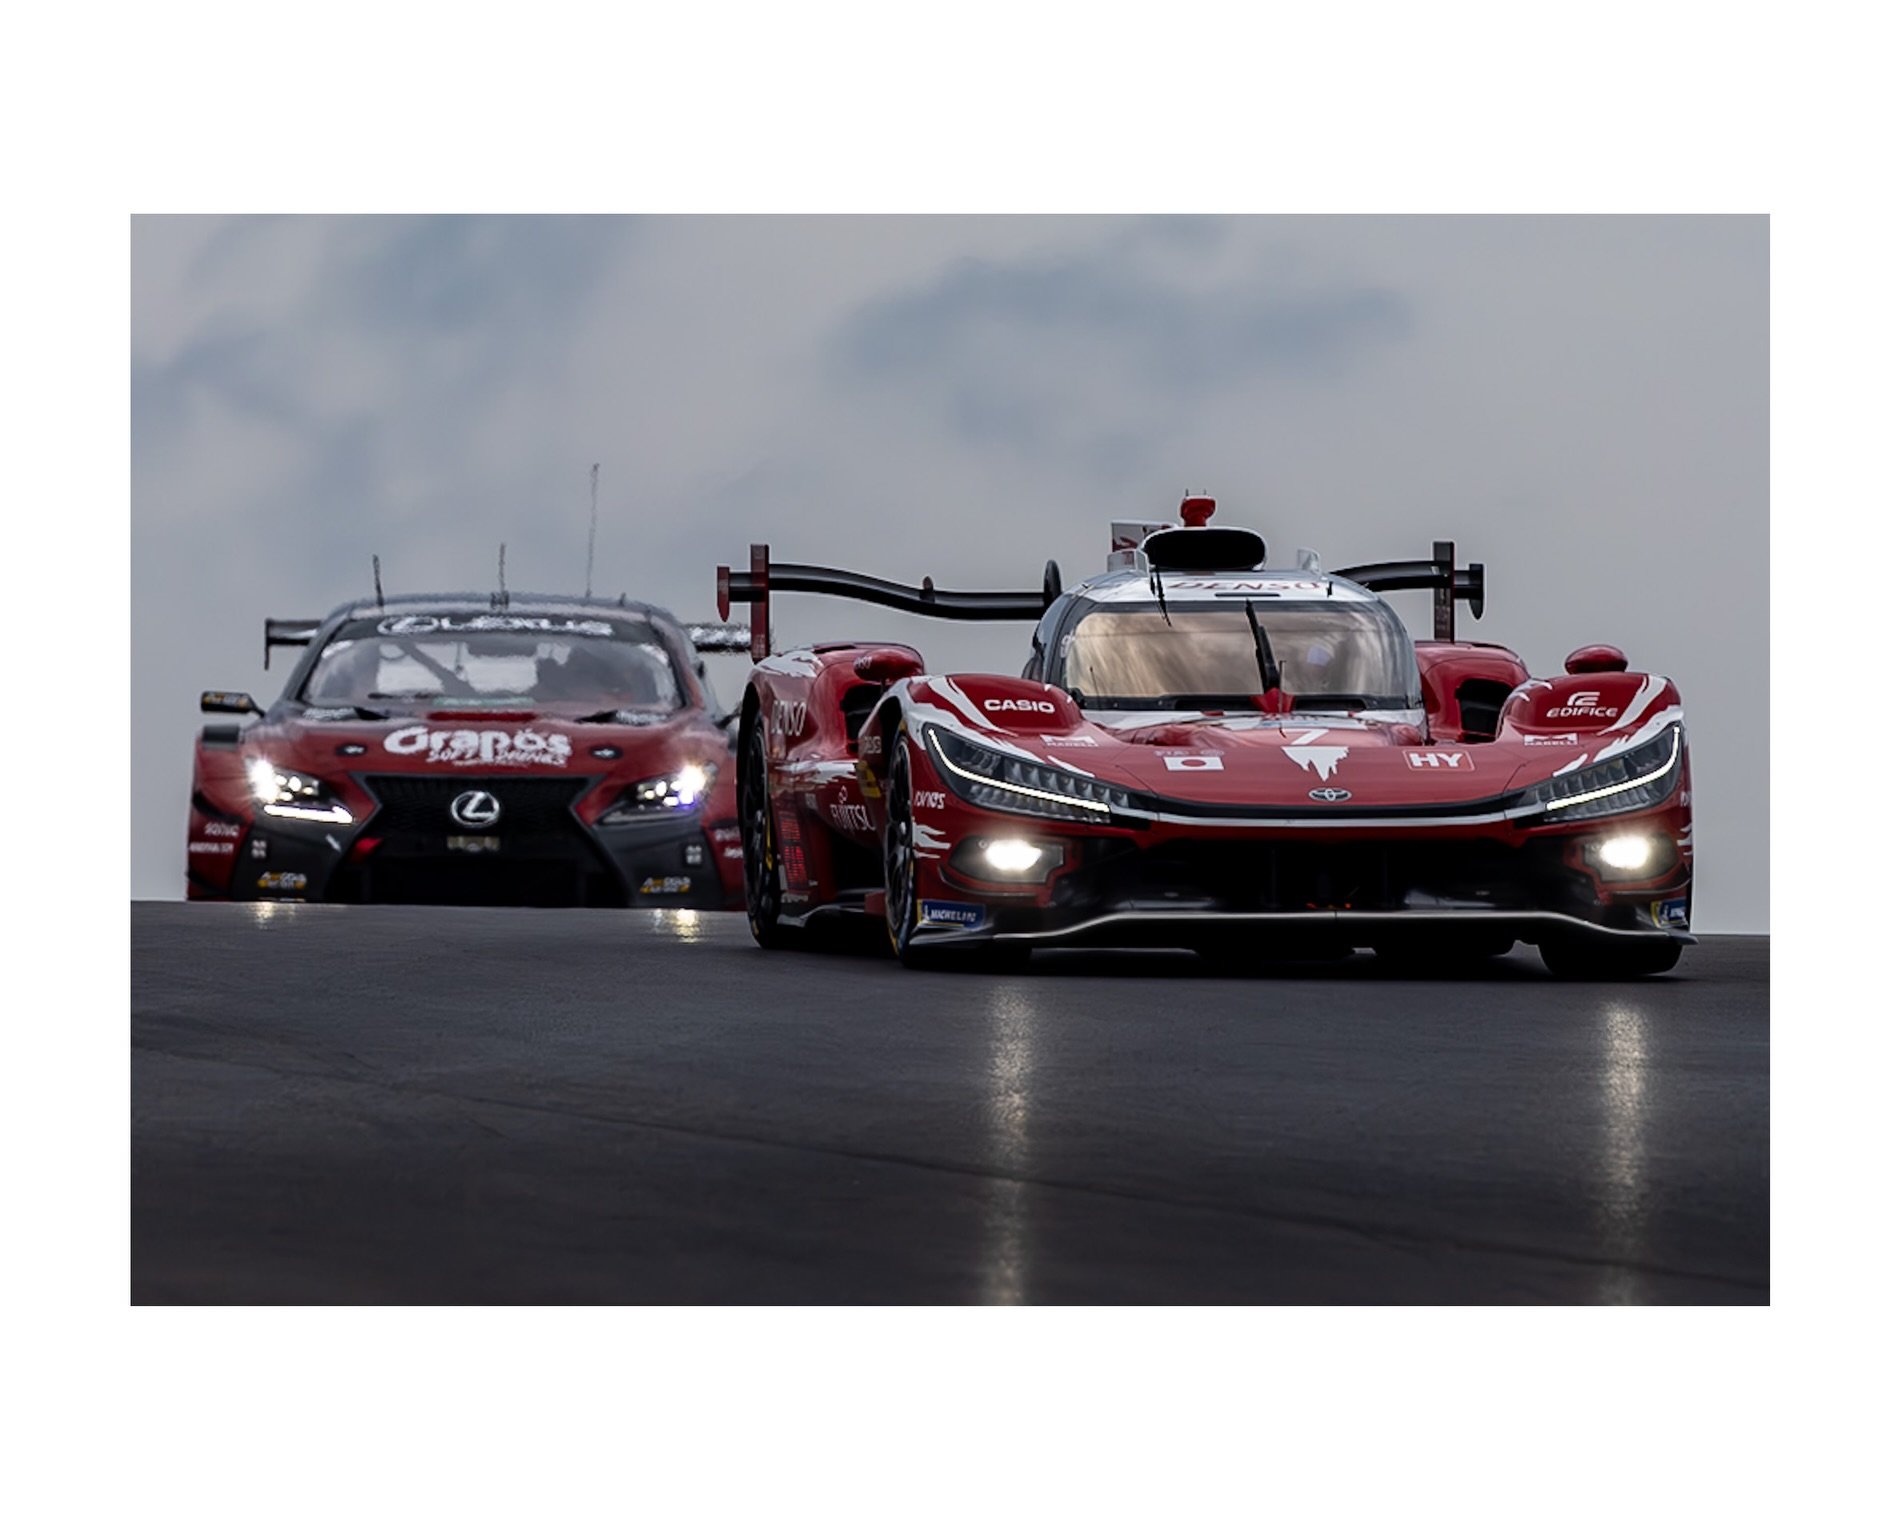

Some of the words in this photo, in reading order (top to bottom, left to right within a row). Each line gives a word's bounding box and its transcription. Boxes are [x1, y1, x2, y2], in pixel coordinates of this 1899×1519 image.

[441, 616, 613, 636] LEXUS
[984, 699, 1055, 713] CASIO
[1547, 706, 1618, 718] EDIFICE
[1408, 751, 1464, 768] HY
